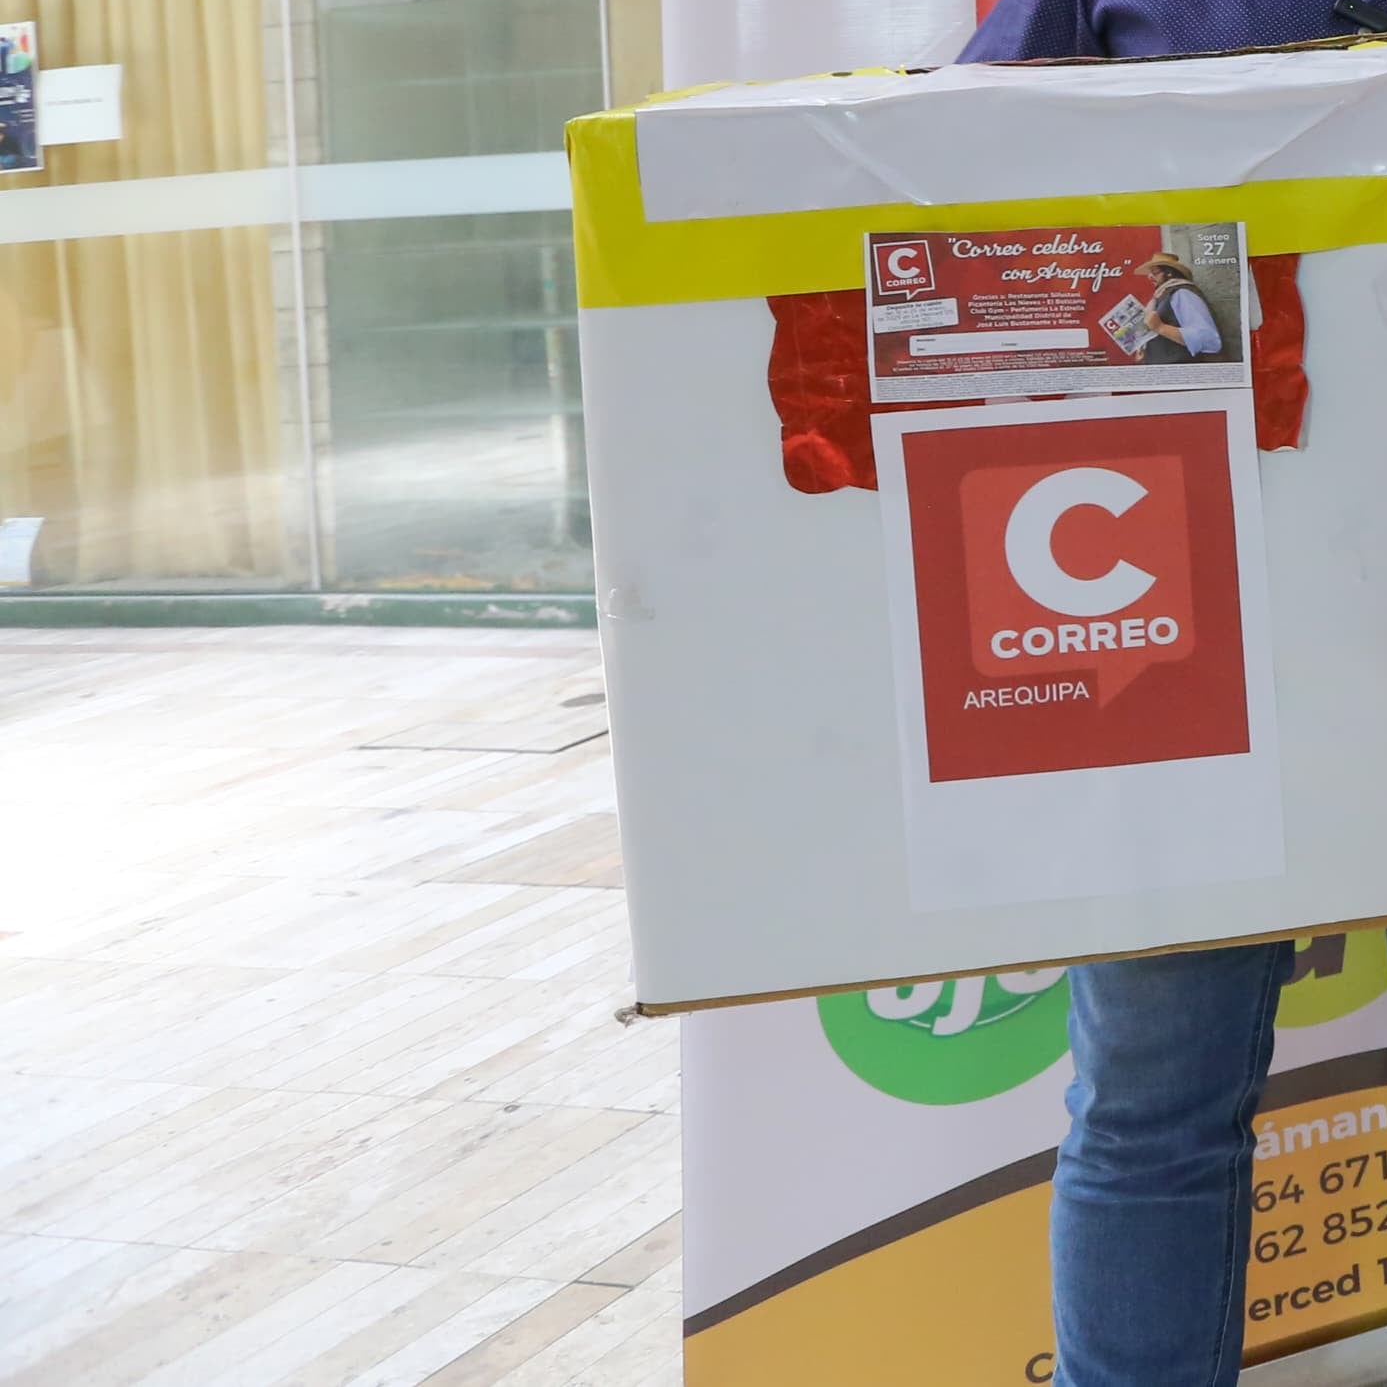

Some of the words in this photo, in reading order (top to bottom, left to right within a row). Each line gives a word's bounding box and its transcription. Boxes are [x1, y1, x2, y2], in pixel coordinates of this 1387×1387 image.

[1032, 234, 1104, 255] celebra
[1197, 234, 1230, 242] Sorteo
[1203, 242, 1225, 256] 27
[886, 276, 926, 288] CORREO
[1002, 267, 1033, 281] con
[1004, 467, 1157, 617] C
[990, 615, 1181, 661] CORREO
[963, 679, 1090, 711] AREQUIPA
[1252, 1174, 1304, 1214] 64
[1251, 1224, 1307, 1264] 62
[1247, 1262, 1362, 1322] erced
